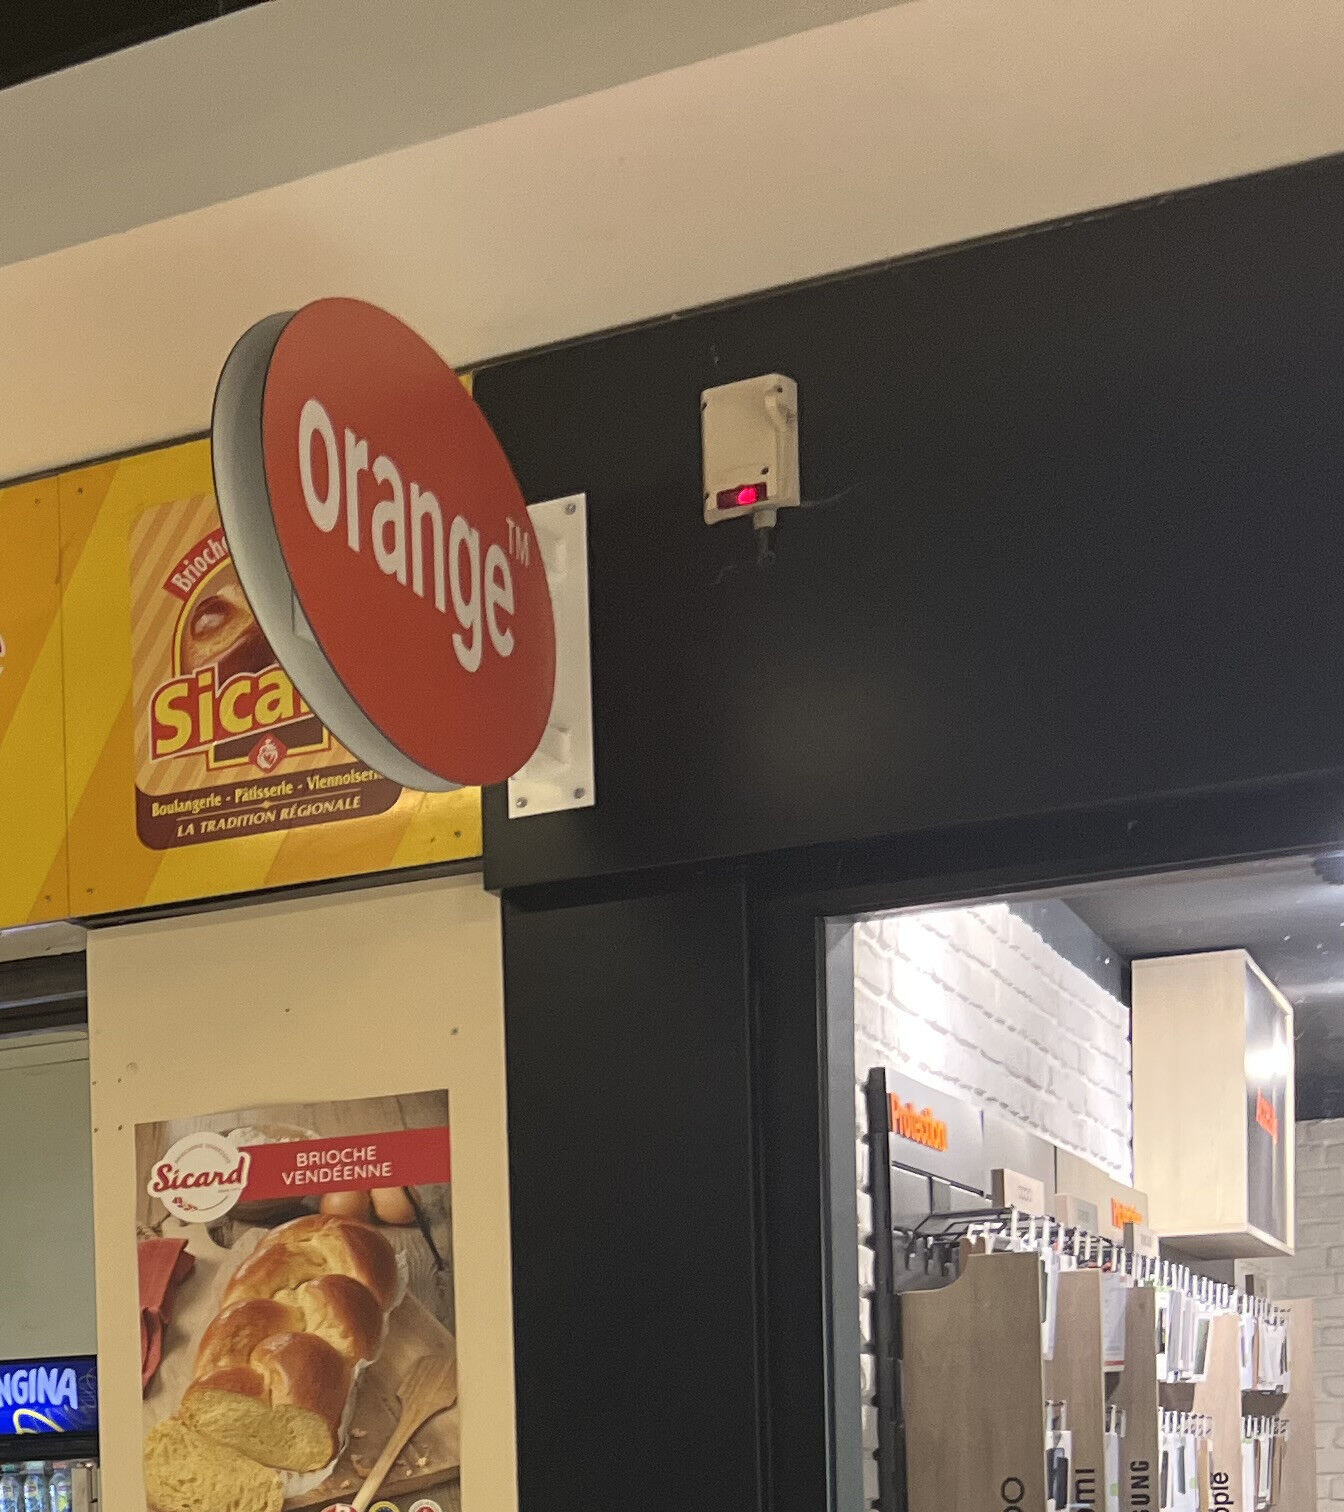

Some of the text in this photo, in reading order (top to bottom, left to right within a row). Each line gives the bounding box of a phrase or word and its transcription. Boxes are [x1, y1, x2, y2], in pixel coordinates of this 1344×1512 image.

[153, 670, 316, 756] Sica
[176, 795, 361, 839] LA TRADITION RÉGIONALE
[151, 1155, 246, 1193] Sicard
[281, 1159, 393, 1186] VENDÉENNE
[296, 1145, 378, 1168] BRIOCHE
